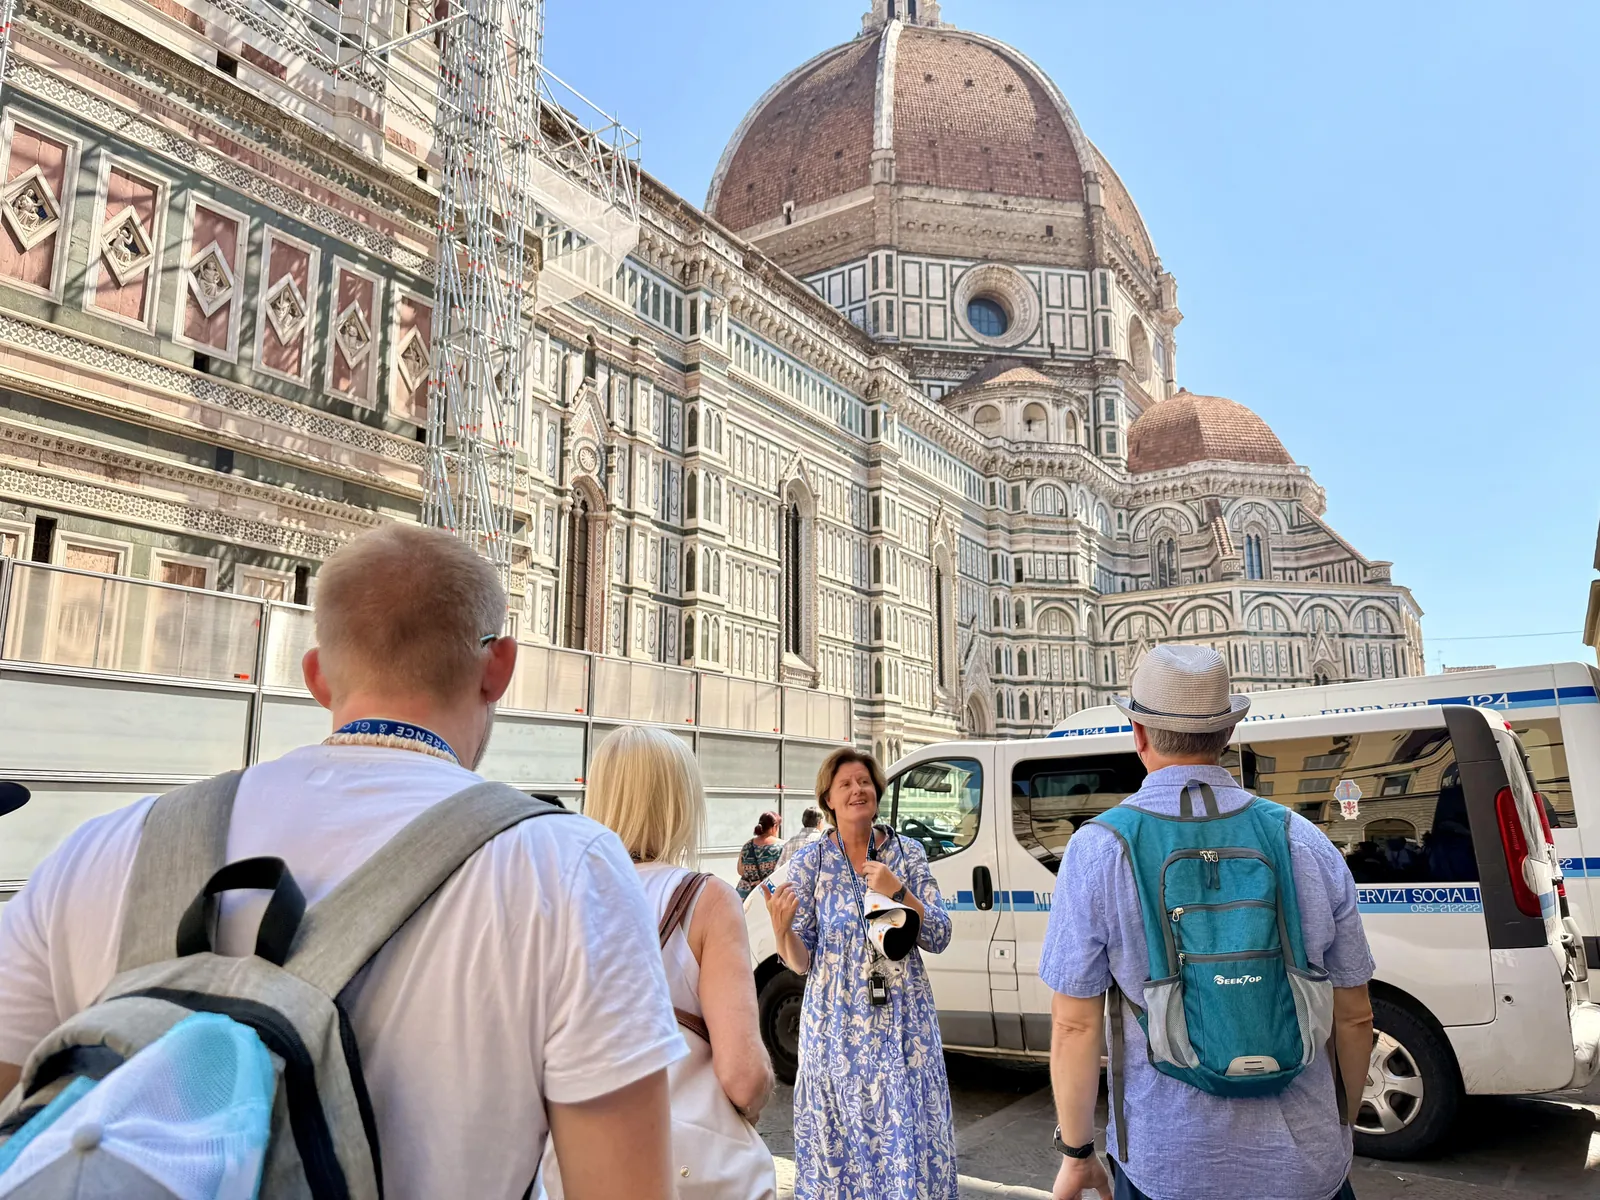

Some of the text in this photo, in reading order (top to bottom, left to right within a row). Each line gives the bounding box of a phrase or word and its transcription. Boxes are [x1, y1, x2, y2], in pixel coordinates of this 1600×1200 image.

[1467, 693, 1513, 709] 124
[379, 723, 389, 733] &
[1082, 726, 1107, 737] 1244
[396, 725, 450, 754] ORENCE
[1035, 892, 1053, 911] MI
[1356, 887, 1480, 903] ERVIZI SOCIALI
[1410, 903, 1480, 913] 055-212222
